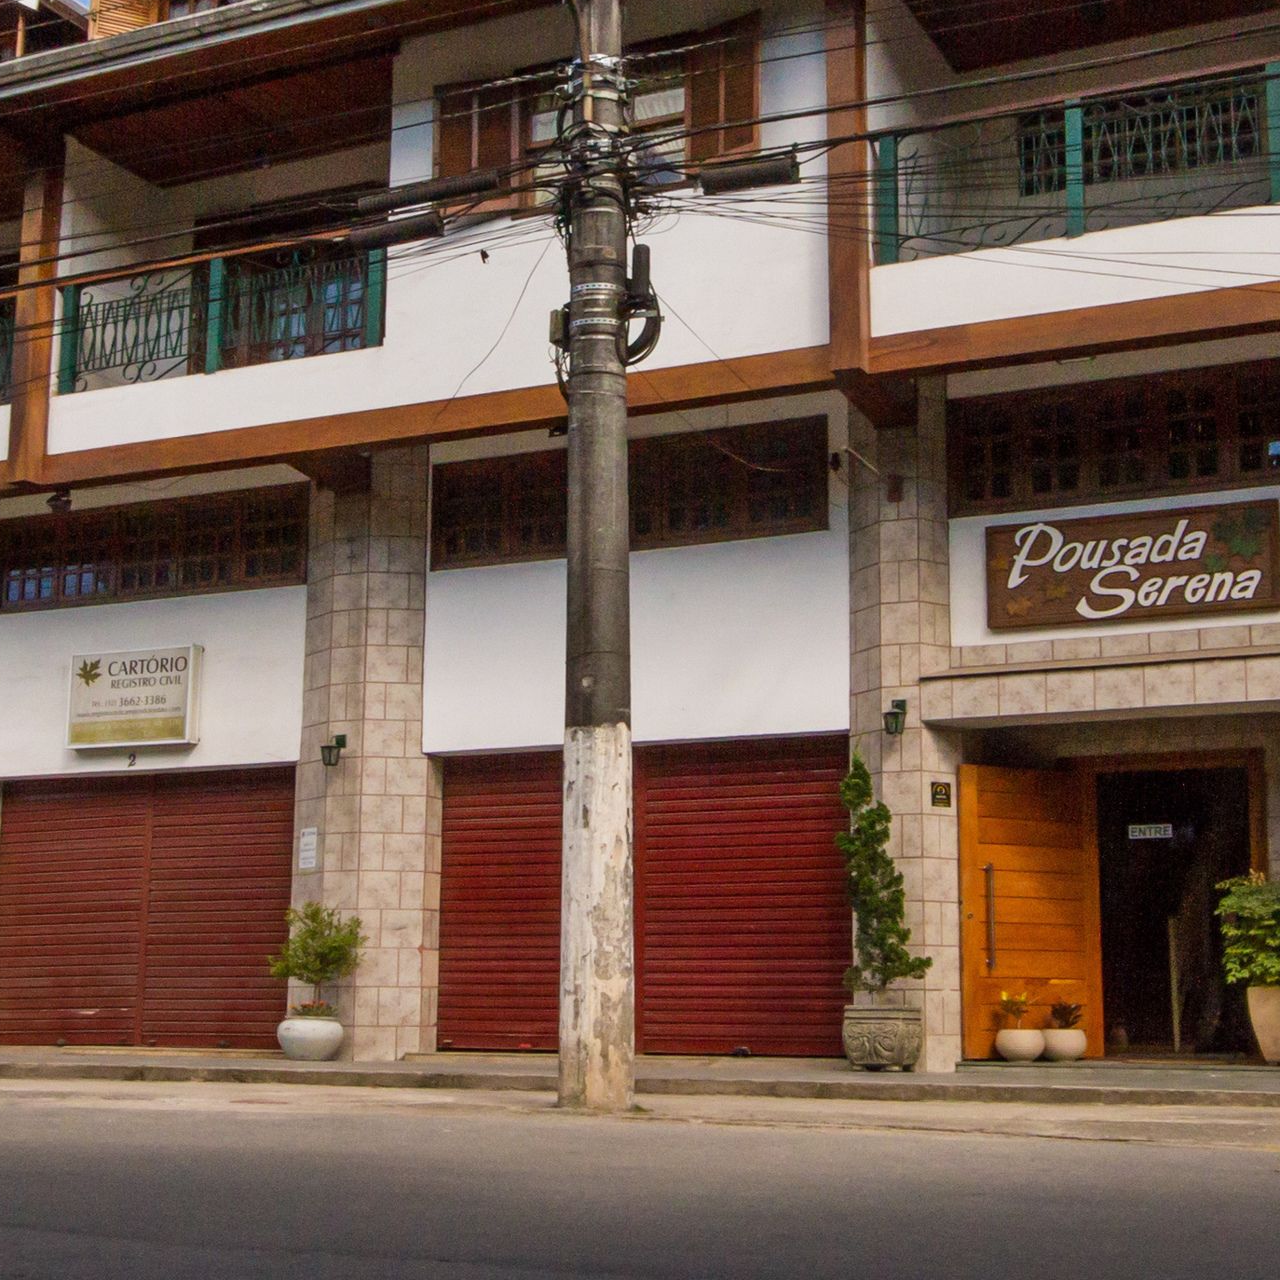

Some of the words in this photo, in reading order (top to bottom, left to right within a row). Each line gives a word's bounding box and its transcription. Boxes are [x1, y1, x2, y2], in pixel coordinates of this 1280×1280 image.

[1007, 520, 1208, 589] Pousada
[1075, 565, 1261, 619] Serena
[108, 655, 188, 677] CARTÓRIO
[110, 677, 157, 689] REGISTRO
[159, 675, 183, 687] CIVIL
[119, 695, 167, 708] 3662-3386
[128, 753, 136, 768] 2
[1130, 825, 1171, 838] ENTRE
